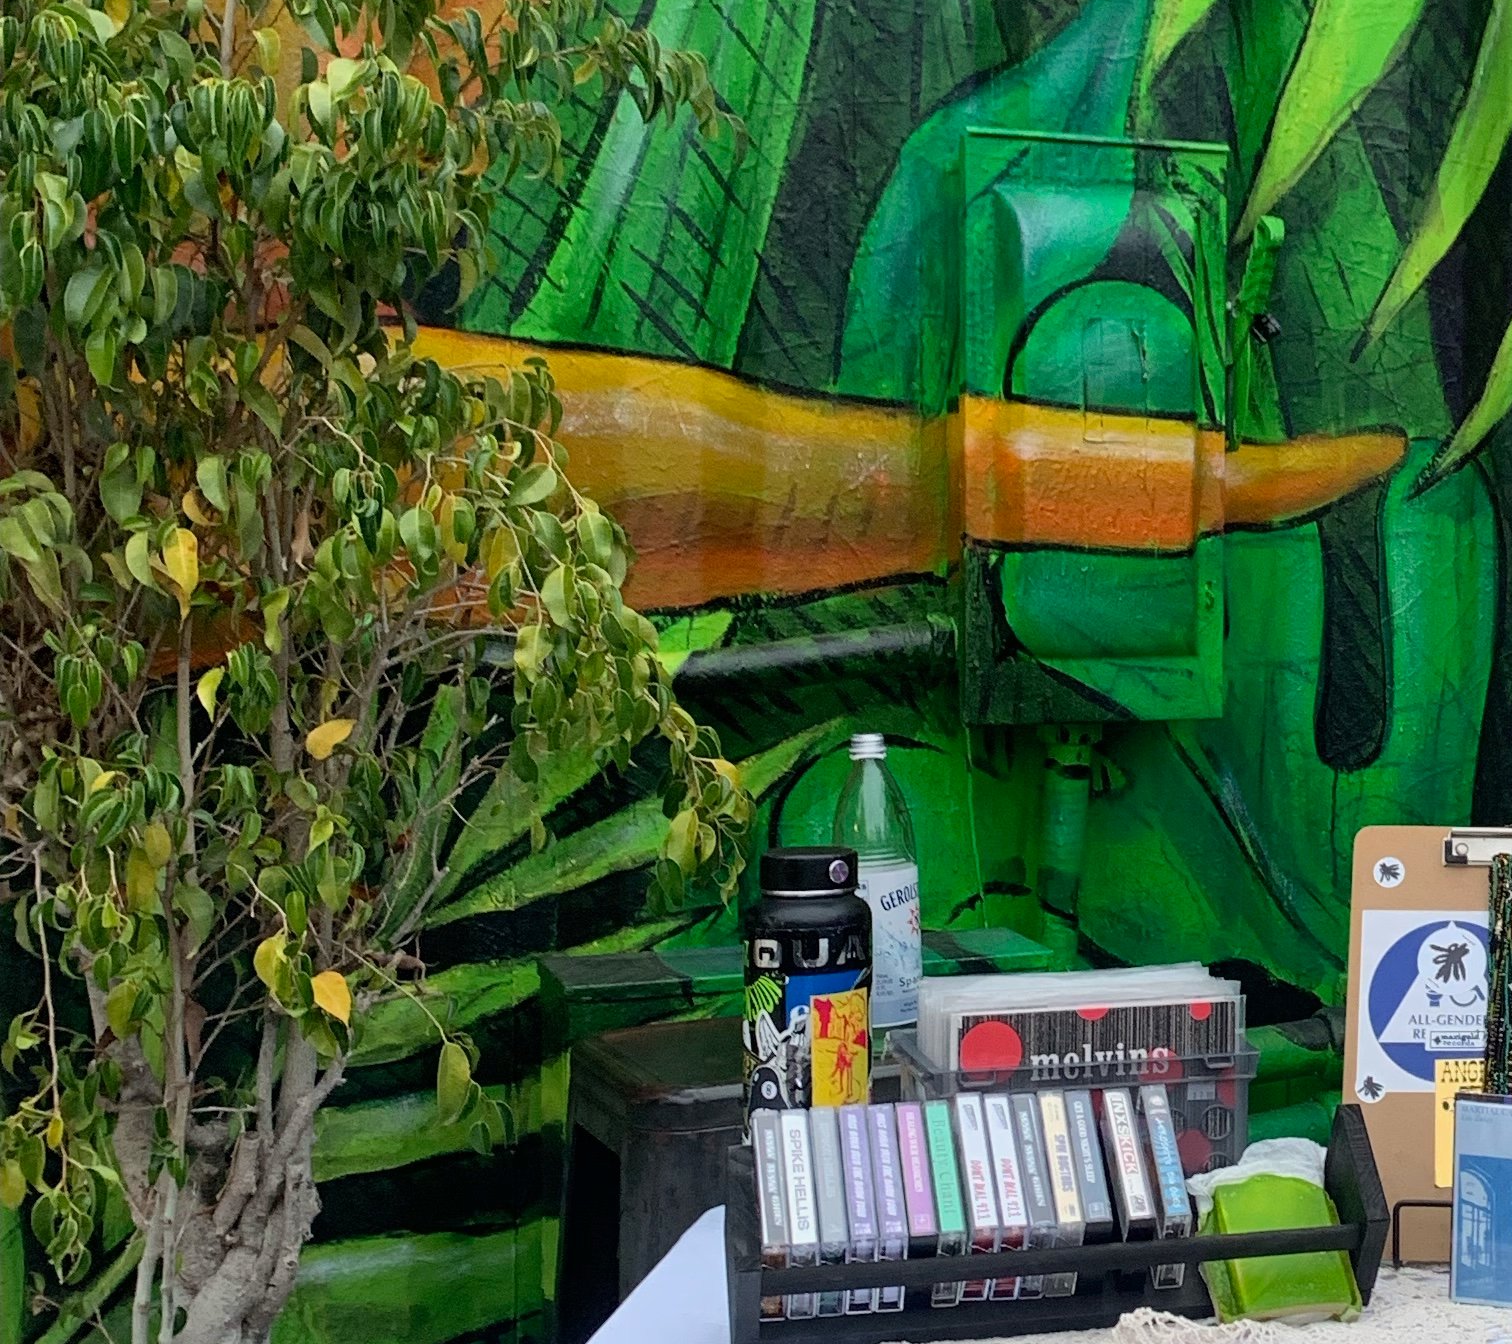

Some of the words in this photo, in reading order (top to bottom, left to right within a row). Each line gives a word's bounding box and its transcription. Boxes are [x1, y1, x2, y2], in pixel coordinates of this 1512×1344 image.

[1408, 1014, 1487, 1027] ALL-GENDE
[1029, 1042, 1170, 1082] melvins
[789, 1130, 803, 1174] SPIKE
[933, 1119, 949, 1166] Beauty
[1110, 1096, 1130, 1136] INXS
[1120, 1136, 1138, 1175] KICK
[793, 1176, 810, 1231] HELLIS
[940, 1171, 956, 1214] Chant
